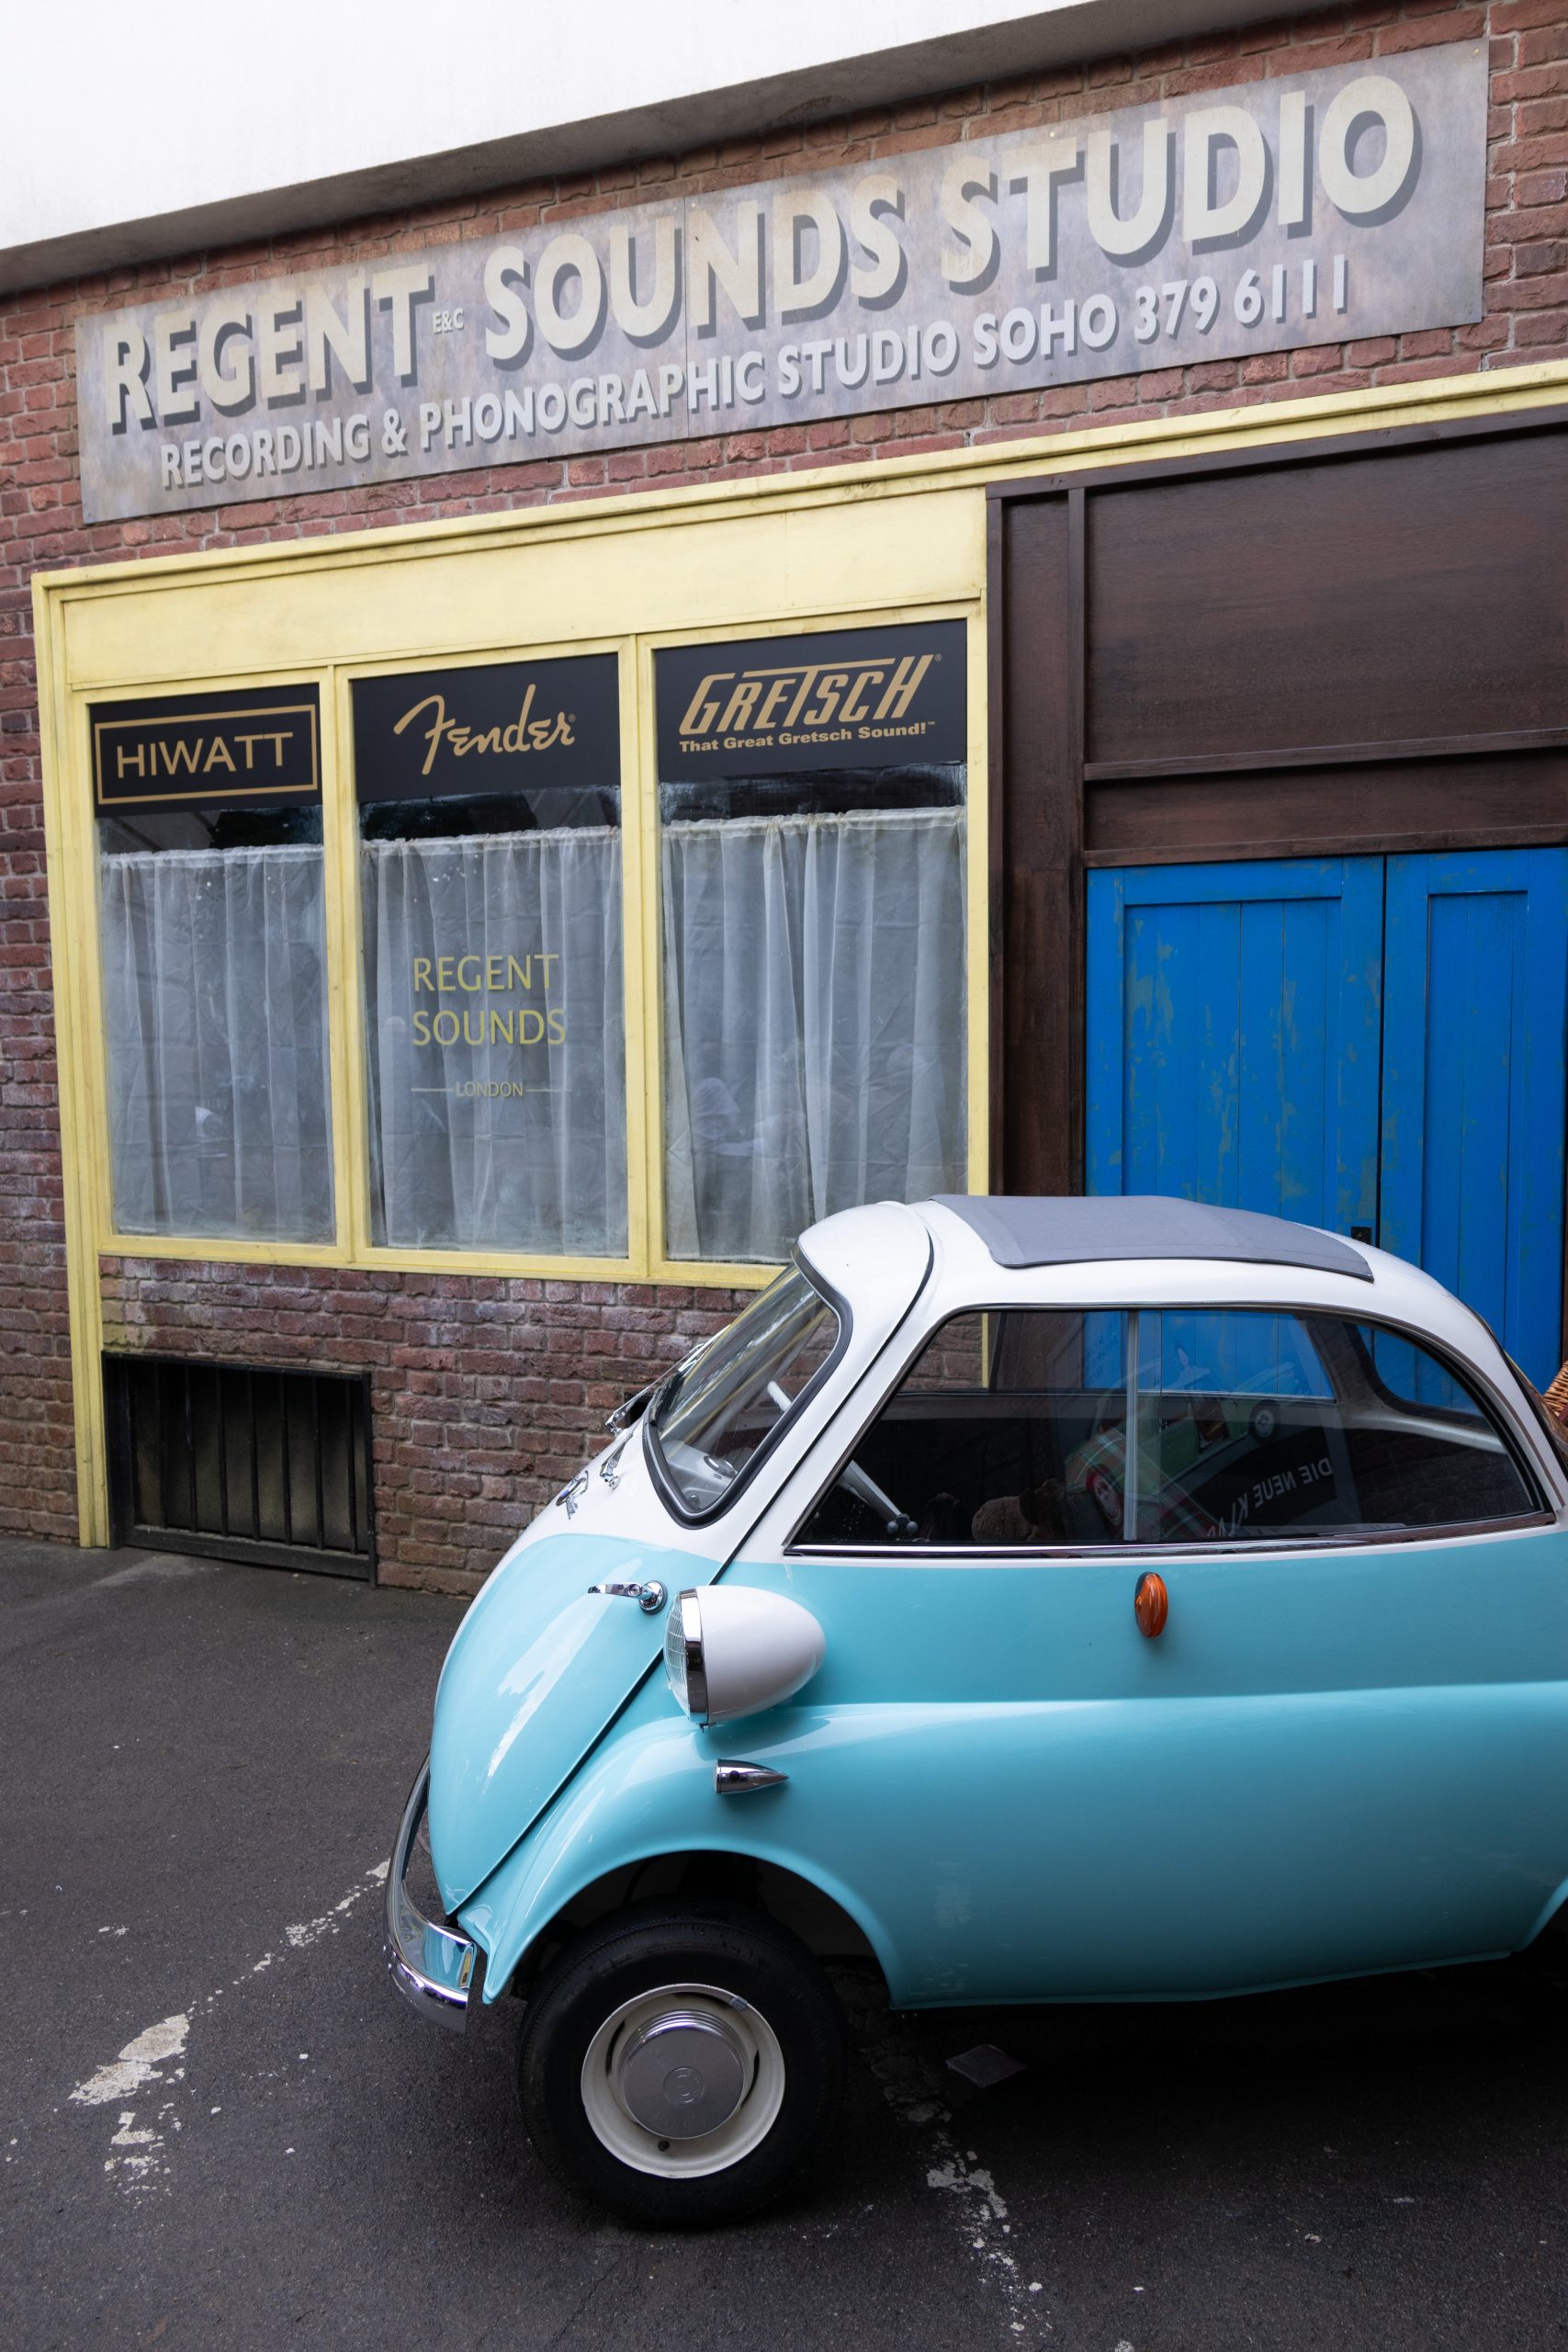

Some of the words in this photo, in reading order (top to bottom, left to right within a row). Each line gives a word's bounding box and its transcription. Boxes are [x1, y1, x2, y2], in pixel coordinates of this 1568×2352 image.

[103, 263, 433, 430] REGENT
[432, 306, 465, 334] E&C
[483, 175, 907, 366] SOUNDS
[941, 75, 1418, 290] STUDIO
[160, 414, 371, 488] RECORDING
[382, 409, 408, 455] &
[421, 351, 765, 449] PHONOGRAPHIC
[778, 310, 959, 396] STUDIO
[973, 293, 1117, 368] SOHO
[1134, 277, 1218, 343] 379
[1235, 254, 1348, 324] 6111
[116, 731, 294, 779] HIWATT
[679, 739, 719, 753] That
[723, 735, 773, 750] Great
[779, 729, 852, 745] Gretsch
[413, 954, 559, 992] REGENT
[412, 1009, 567, 1046] SOUNDS
[456, 1080, 524, 1098] LONDON
